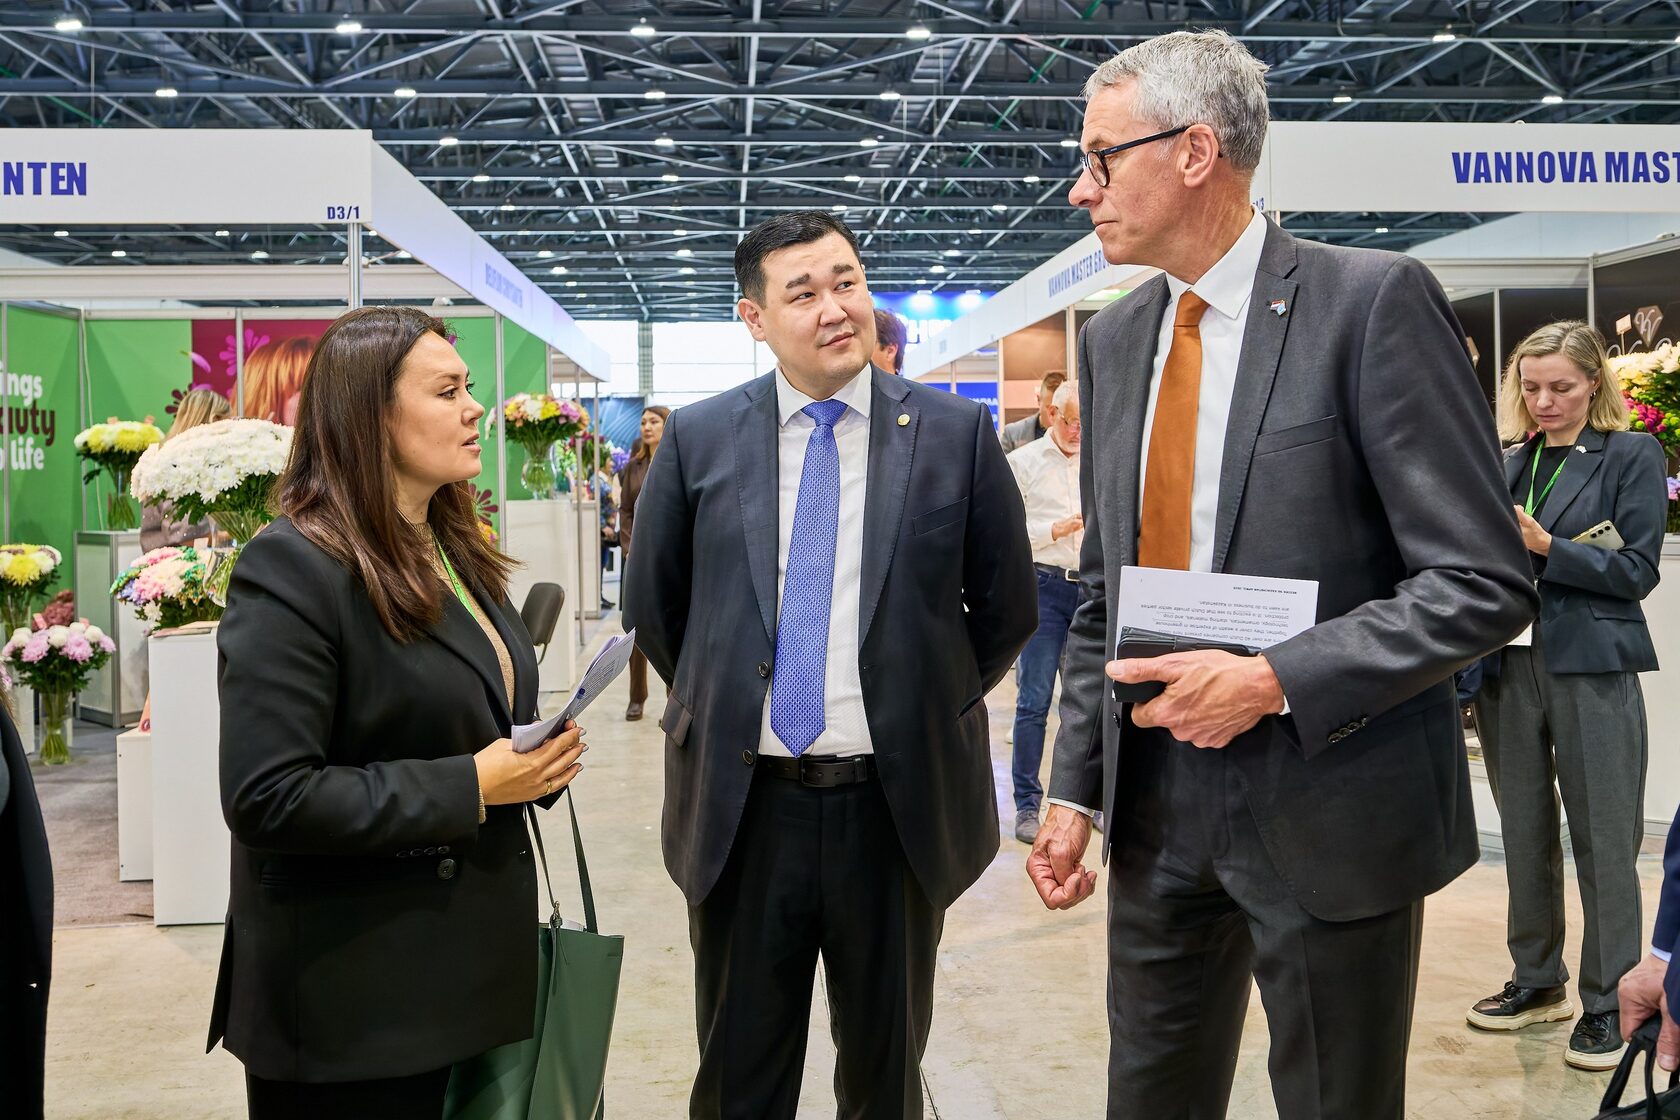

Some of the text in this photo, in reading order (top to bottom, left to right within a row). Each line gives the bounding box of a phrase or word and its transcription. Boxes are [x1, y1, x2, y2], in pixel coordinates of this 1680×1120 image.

[1451, 151, 1598, 184] VANNOVA
[327, 206, 360, 220] D3/1
[1072, 254, 1093, 286] MASTER
[10, 436, 44, 470] life
